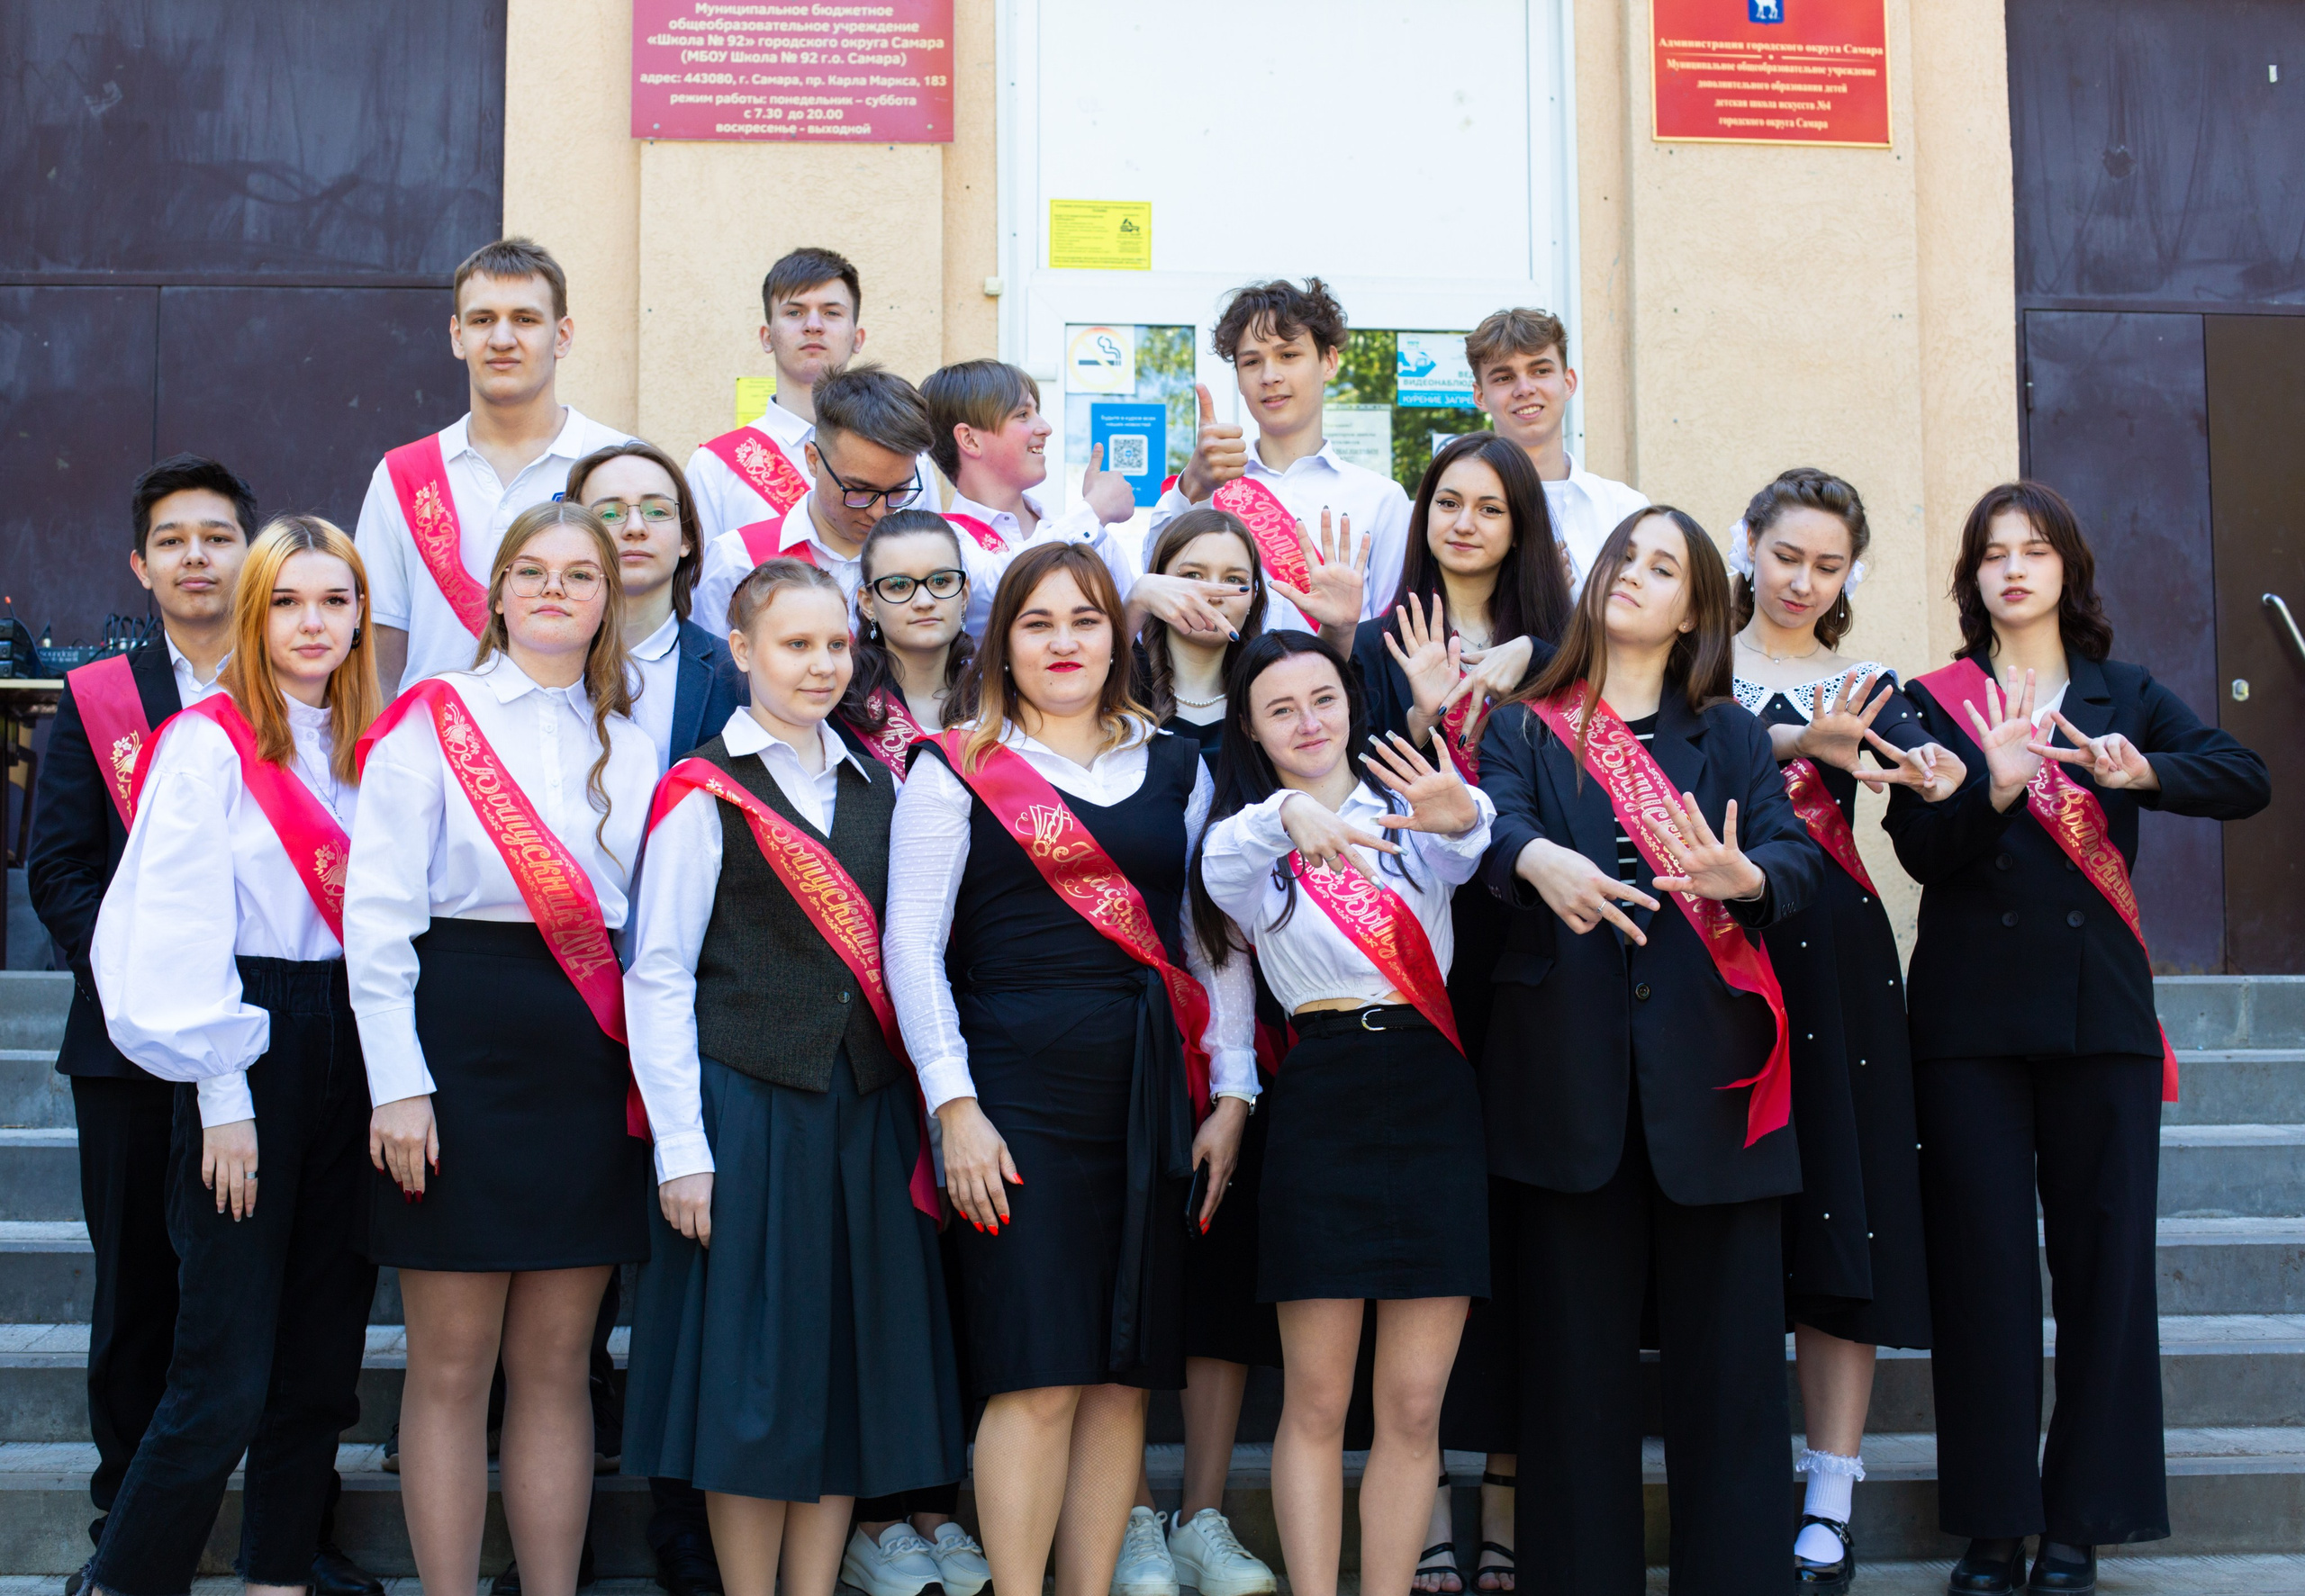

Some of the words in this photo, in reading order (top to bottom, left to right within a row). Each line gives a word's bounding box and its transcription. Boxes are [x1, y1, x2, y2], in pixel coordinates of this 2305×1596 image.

[695, 3, 809, 16] Муниципальное
[811, 4, 894, 17] бюджетное
[668, 17, 830, 32] общеобразовательное
[832, 22, 919, 34] учреждение
[646, 34, 705, 46] «Школа
[708, 34, 724, 46] №
[727, 35, 755, 47] 92»
[758, 37, 838, 50] городского
[840, 39, 889, 51] округа
[891, 36, 945, 51] Самара
[1659, 38, 1744, 51] Администрация
[1747, 41, 1803, 52] городского
[1805, 44, 1841, 55] округа
[1843, 43, 1884, 57] Самара
[681, 49, 728, 65] (МБОУ
[730, 51, 778, 63] Школа
[781, 51, 798, 63] №
[800, 52, 818, 64] 92
[821, 53, 845, 64] г.о.
[847, 52, 907, 68] Самара)
[1667, 59, 1736, 71] Муниципальное
[1828, 66, 1876, 77] учреждение
[640, 73, 682, 85] адрес:
[683, 73, 737, 86] 443080,
[738, 75, 749, 85] г.
[751, 74, 803, 87] Самара,
[806, 76, 826, 87] пр.
[827, 76, 867, 87] Карла
[869, 76, 921, 88] Маркса,
[924, 75, 947, 86] 183
[1824, 83, 1848, 94] детей
[670, 94, 713, 105] режим
[715, 93, 767, 106] работы:
[770, 95, 854, 106] понедельник
[865, 94, 917, 108] суббота
[1714, 99, 1748, 108] детская
[1749, 100, 1777, 109] школа
[1778, 101, 1815, 112] искусств
[744, 109, 752, 119] с
[754, 108, 782, 119] 7.30
[787, 110, 805, 121] до
[807, 109, 844, 120] 20.00
[716, 123, 797, 135] воскресенье
[808, 122, 872, 136] выходной
[1719, 117, 1765, 128] городского
[1766, 119, 1794, 130] округа
[1795, 117, 1829, 131] Самара
[1404, 379, 1475, 387] ВИДЕОНАБЛЮД
[1402, 395, 1442, 404] КУРЕНИЕ
[1444, 395, 1475, 404] ЗАПРЕ
[2035, 777, 2137, 915] Выпускник
[552, 919, 615, 982] 2024
